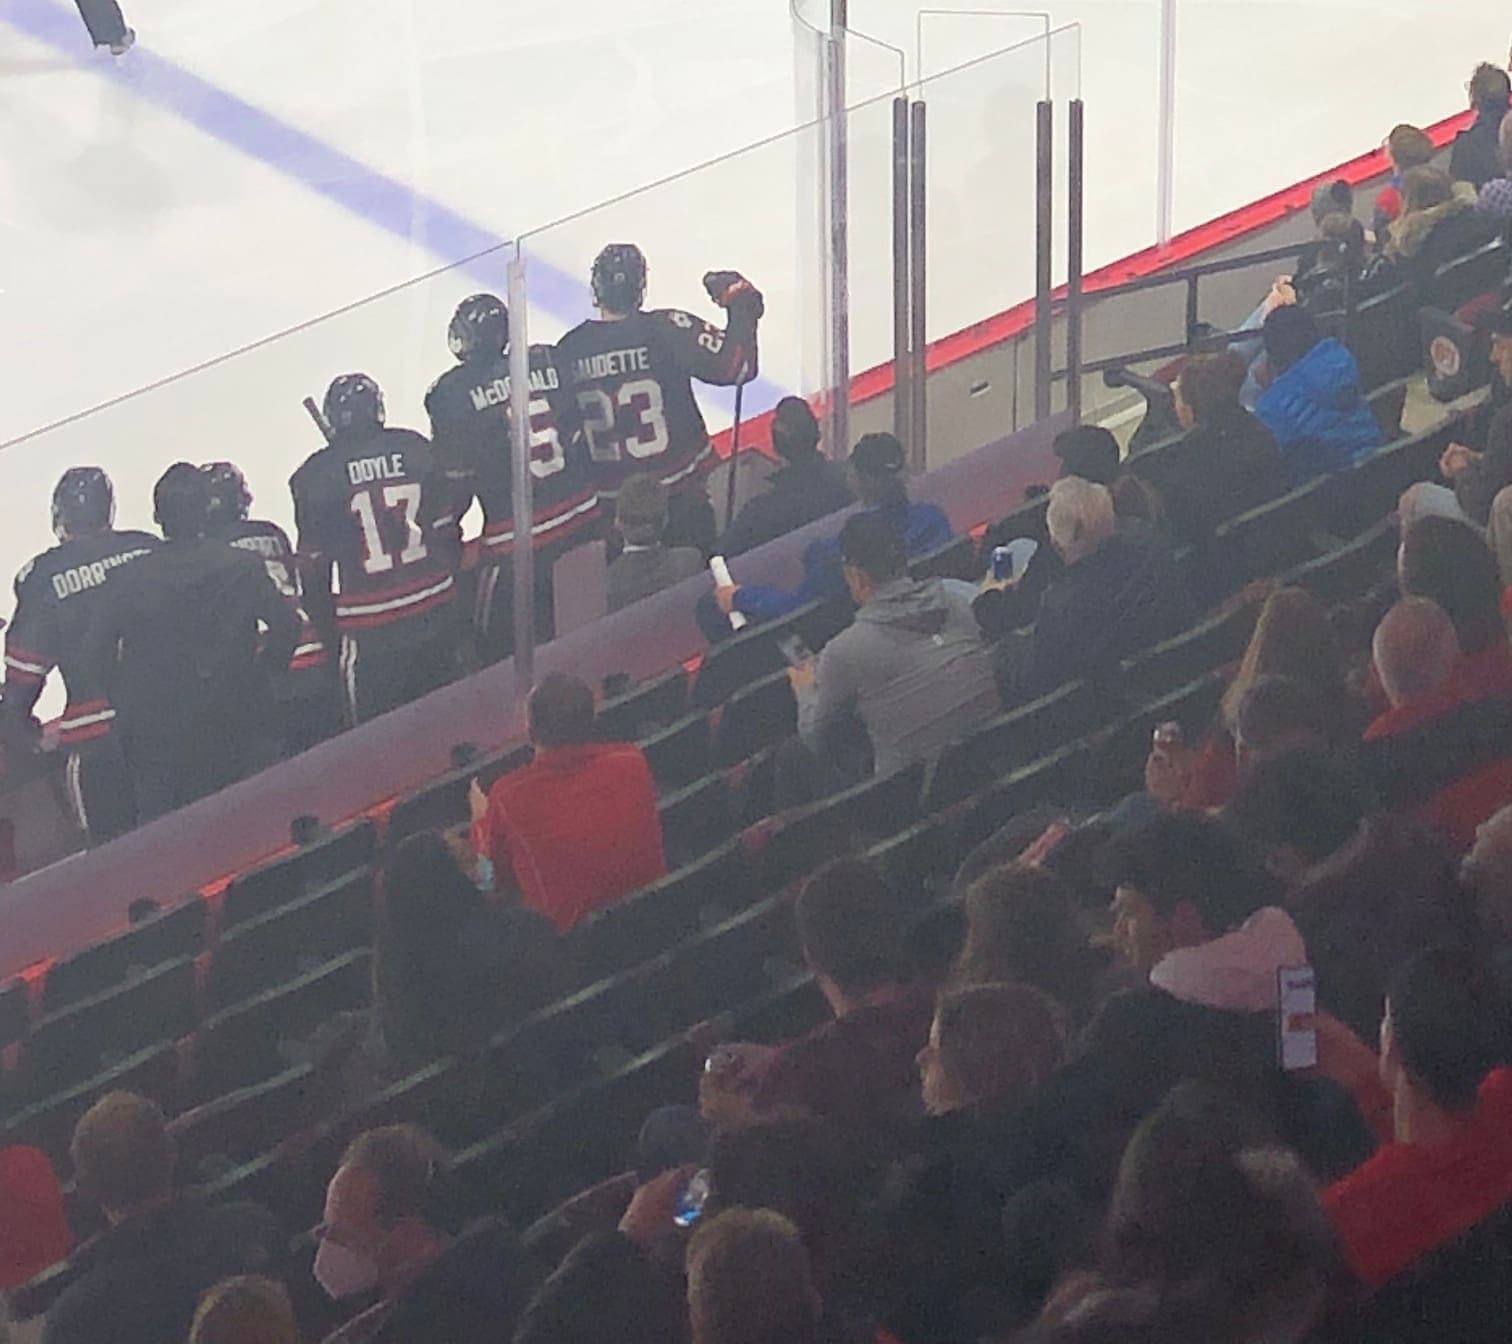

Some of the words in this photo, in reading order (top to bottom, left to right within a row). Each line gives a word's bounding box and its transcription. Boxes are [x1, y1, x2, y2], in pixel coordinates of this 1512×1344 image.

[575, 378, 670, 462] 23
[347, 453, 406, 485] DOYLE
[350, 482, 428, 574] 17
